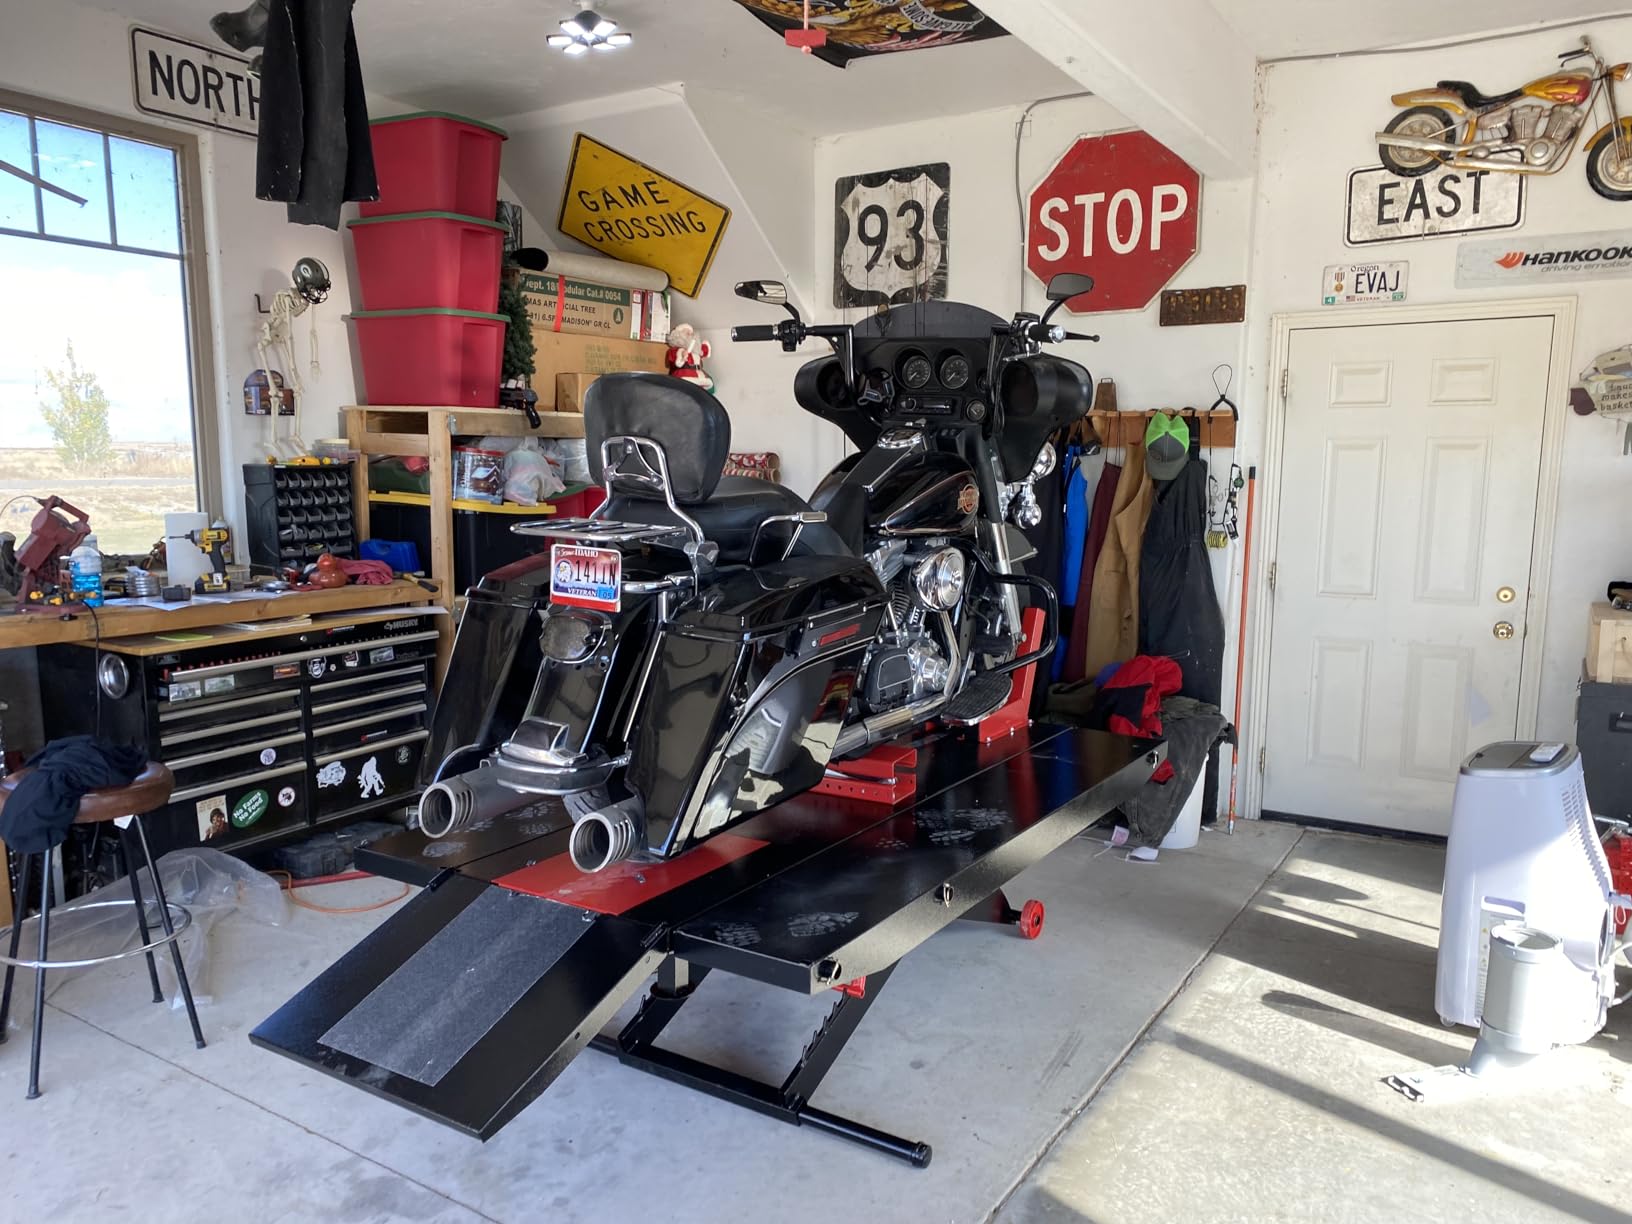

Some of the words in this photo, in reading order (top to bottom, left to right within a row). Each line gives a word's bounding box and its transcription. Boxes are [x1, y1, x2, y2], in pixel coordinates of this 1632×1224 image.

[577, 180, 670, 213] GAME
[1377, 170, 1491, 226] EAST
[583, 210, 707, 243] CROSSING
[1037, 183, 1189, 262] STOP
[857, 199, 925, 273] 93
[1350, 264, 1380, 273] Oregon
[1541, 264, 1582, 273] driving
[1584, 260, 1632, 270] emotio
[1355, 270, 1400, 294] EVAJ
[581, 305, 596, 314] TREE
[575, 548, 599, 557] IDAHO
[567, 587, 598, 598] VETERAN
[392, 619, 419, 629] HUSKY
[233, 808, 243, 819] No
[243, 792, 261, 810] Farms
[238, 811, 249, 822] No
[248, 796, 263, 813] Food
